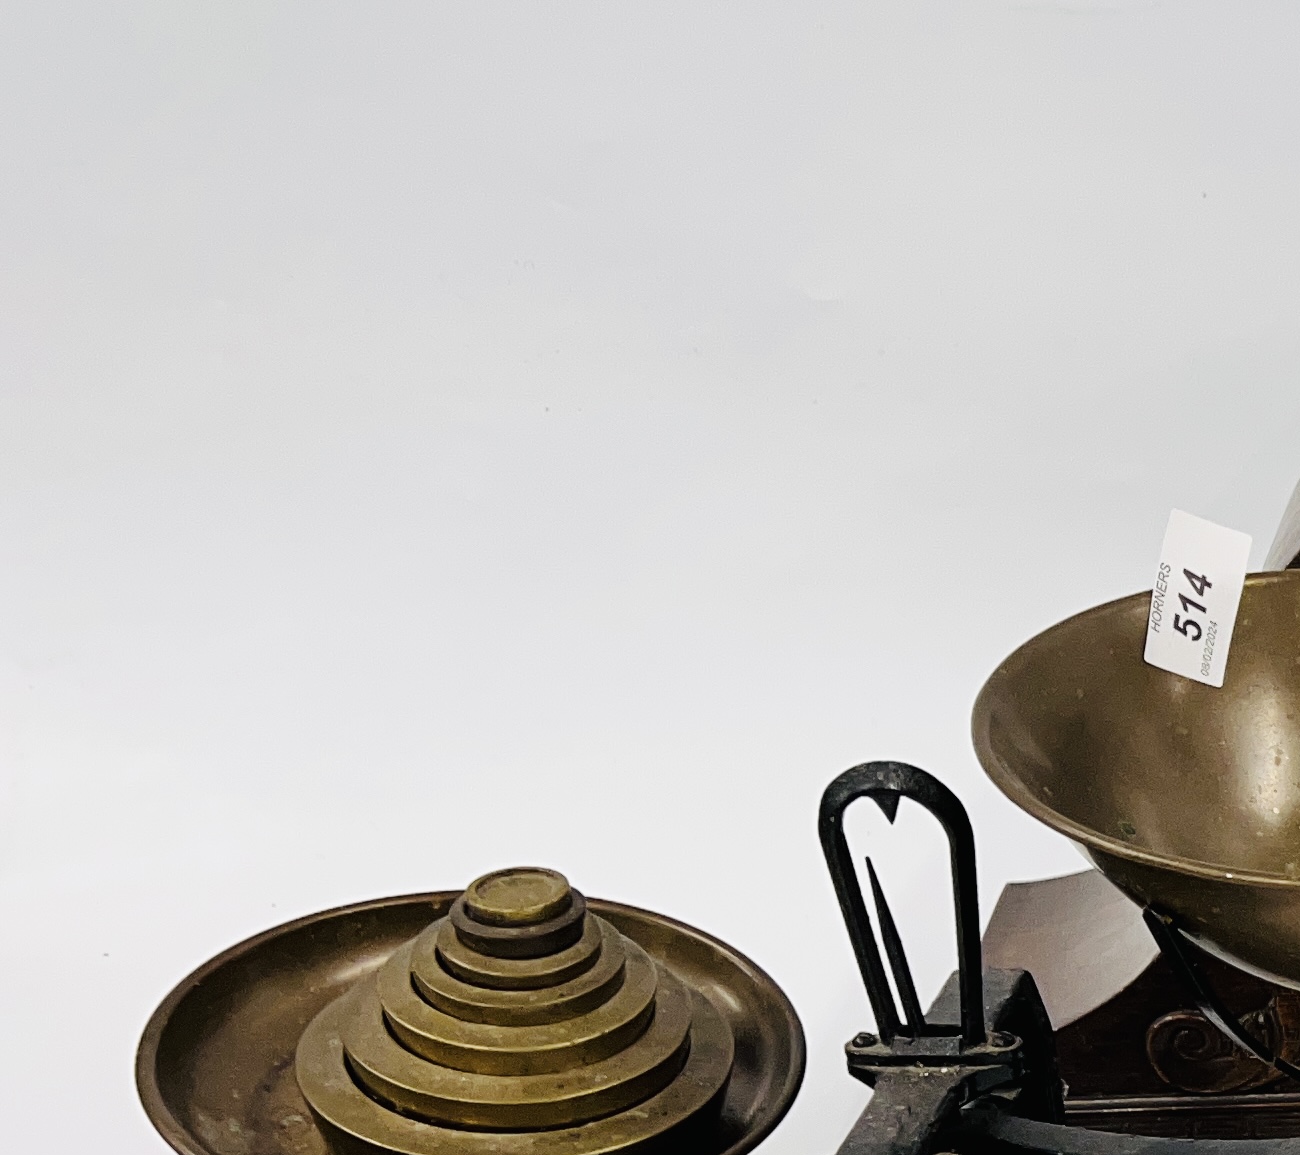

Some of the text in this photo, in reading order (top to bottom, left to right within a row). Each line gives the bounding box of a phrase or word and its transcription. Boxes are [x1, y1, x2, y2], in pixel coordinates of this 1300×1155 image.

[1151, 562, 1171, 632] HORNERS
[1173, 567, 1213, 642] 514
[1201, 620, 1218, 677] 08/02/2024
